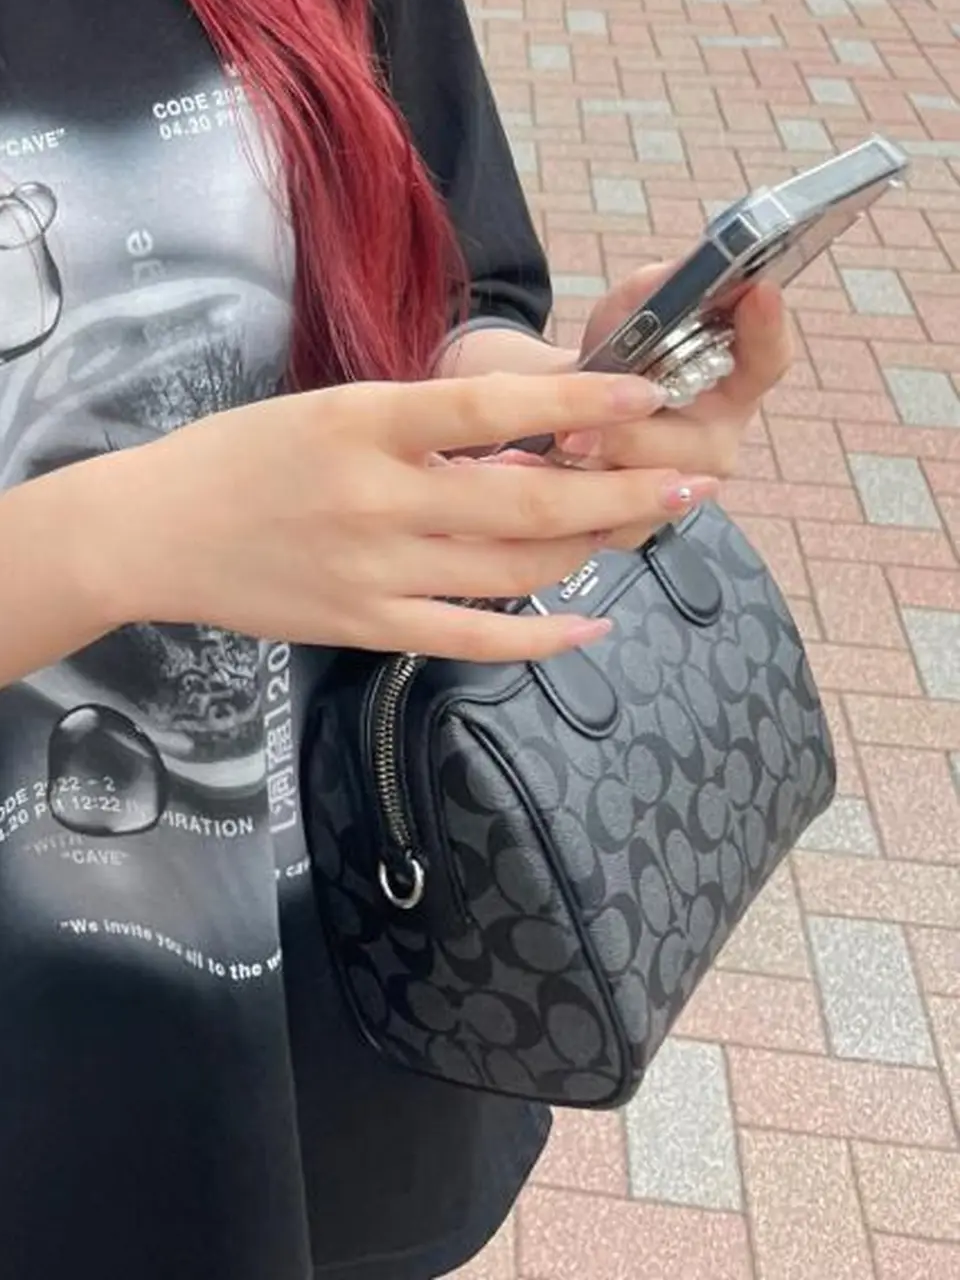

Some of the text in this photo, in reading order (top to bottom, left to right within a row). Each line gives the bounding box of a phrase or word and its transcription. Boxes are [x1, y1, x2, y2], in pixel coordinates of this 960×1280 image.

[152, 92, 209, 119] CODE
[159, 115, 212, 140] 04.20
[104, 918, 152, 941] invite
[186, 949, 204, 969] all
[208, 957, 226, 977] to
[229, 963, 263, 981] the
